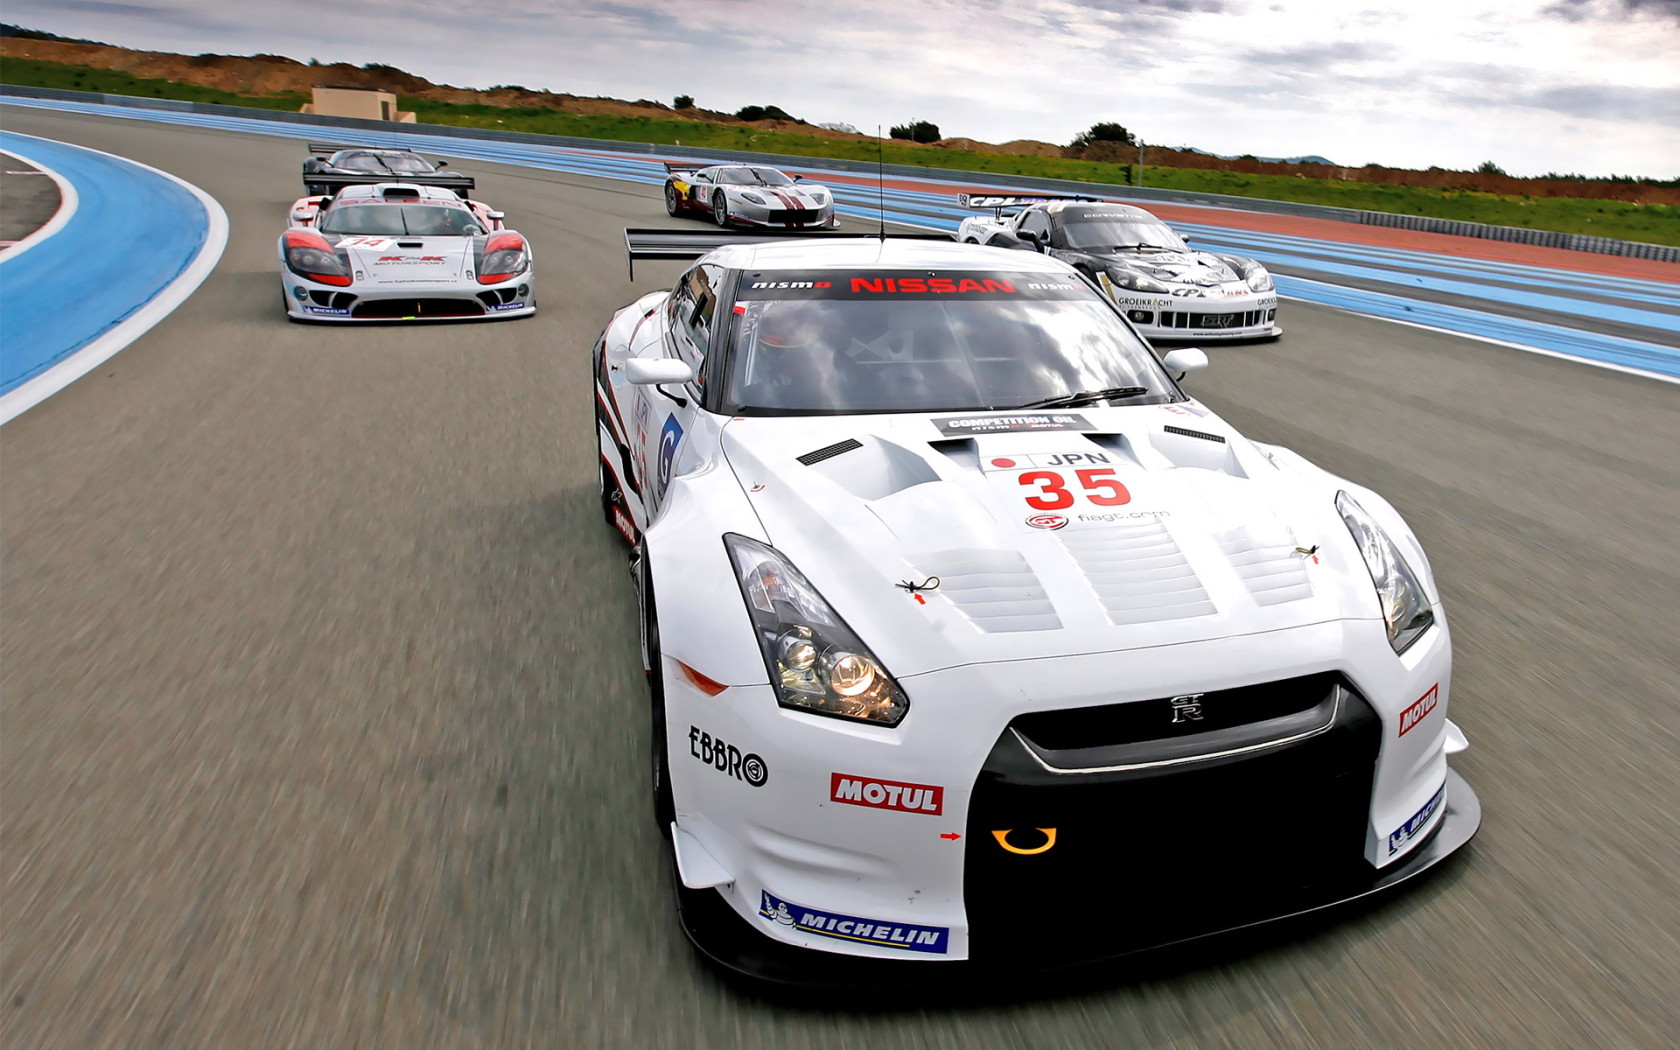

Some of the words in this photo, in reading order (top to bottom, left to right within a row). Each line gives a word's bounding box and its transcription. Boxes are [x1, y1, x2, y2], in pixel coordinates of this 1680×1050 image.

[970, 197, 1017, 207] CPL
[751, 281, 832, 289] nismo
[850, 278, 1017, 293] NISSAN
[1028, 283, 1085, 291] nismo
[1119, 297, 1173, 308] GROEIKRACHT
[948, 416, 1050, 428] COMPETITION
[1052, 415, 1077, 424] OIL
[1047, 452, 1111, 466] JPN
[1018, 468, 1132, 511] 35
[1401, 689, 1436, 733] MOTUL
[688, 725, 768, 788] EBBRO
[836, 778, 938, 812] MOTUL
[800, 913, 940, 946] MICHELIN
